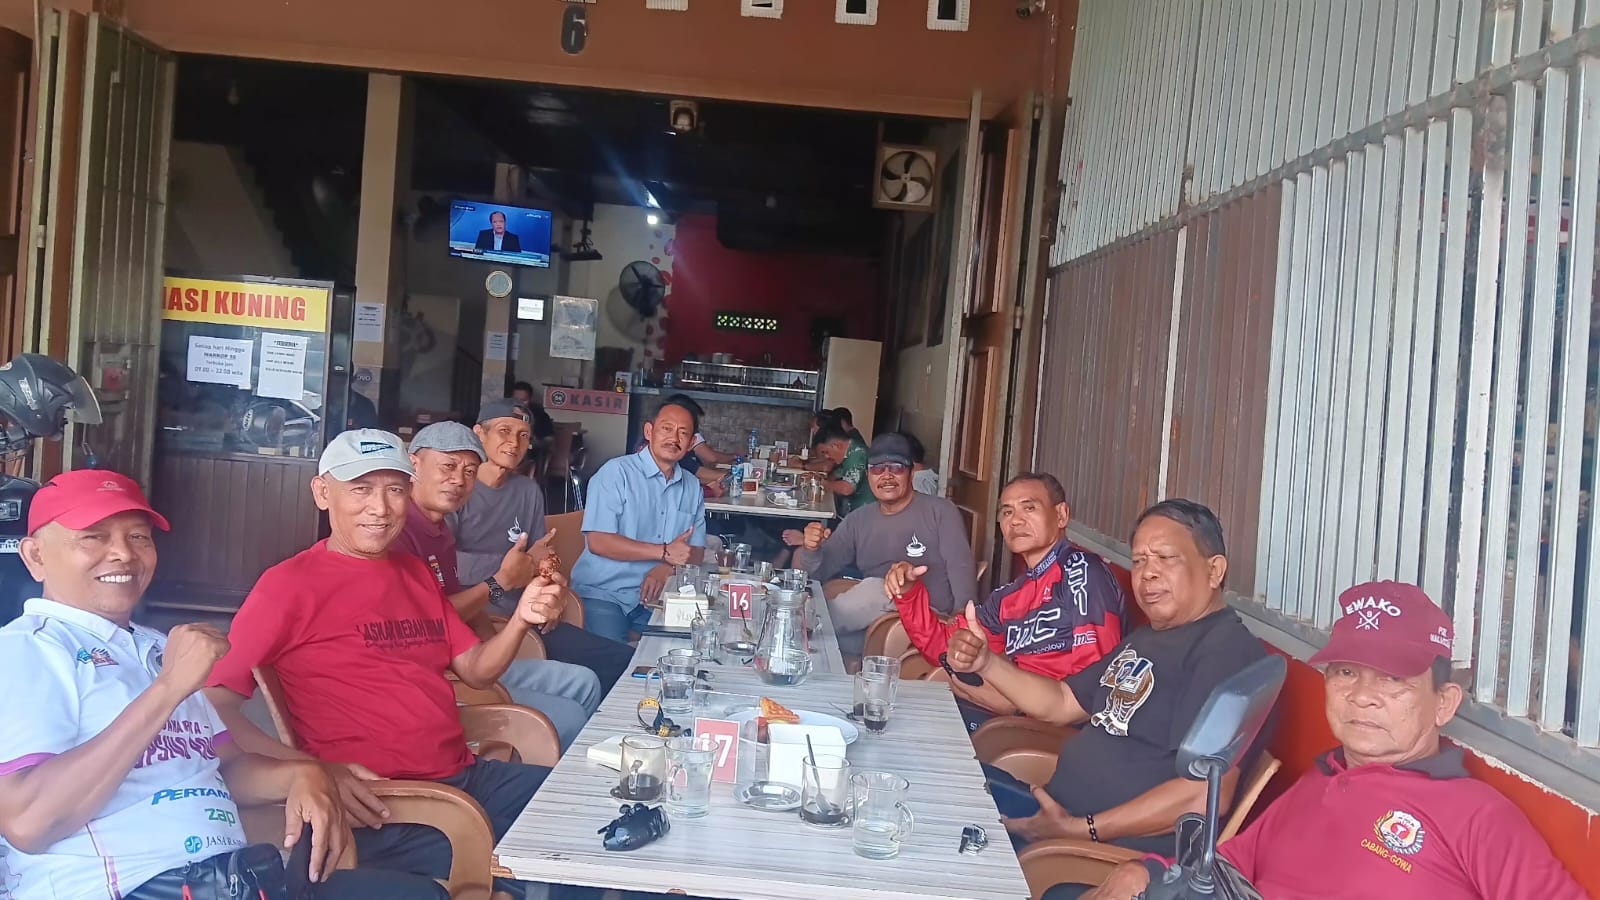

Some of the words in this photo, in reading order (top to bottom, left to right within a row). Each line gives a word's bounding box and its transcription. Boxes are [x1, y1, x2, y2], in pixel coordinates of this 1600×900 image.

[214, 290, 306, 321] KUNING
[570, 393, 623, 409] KASIR
[731, 590, 749, 611] 16
[1345, 596, 1401, 617] EWAKO
[700, 732, 733, 768] 17
[204, 808, 236, 826] zap
[1361, 839, 1412, 873] CABANG-GOWA
